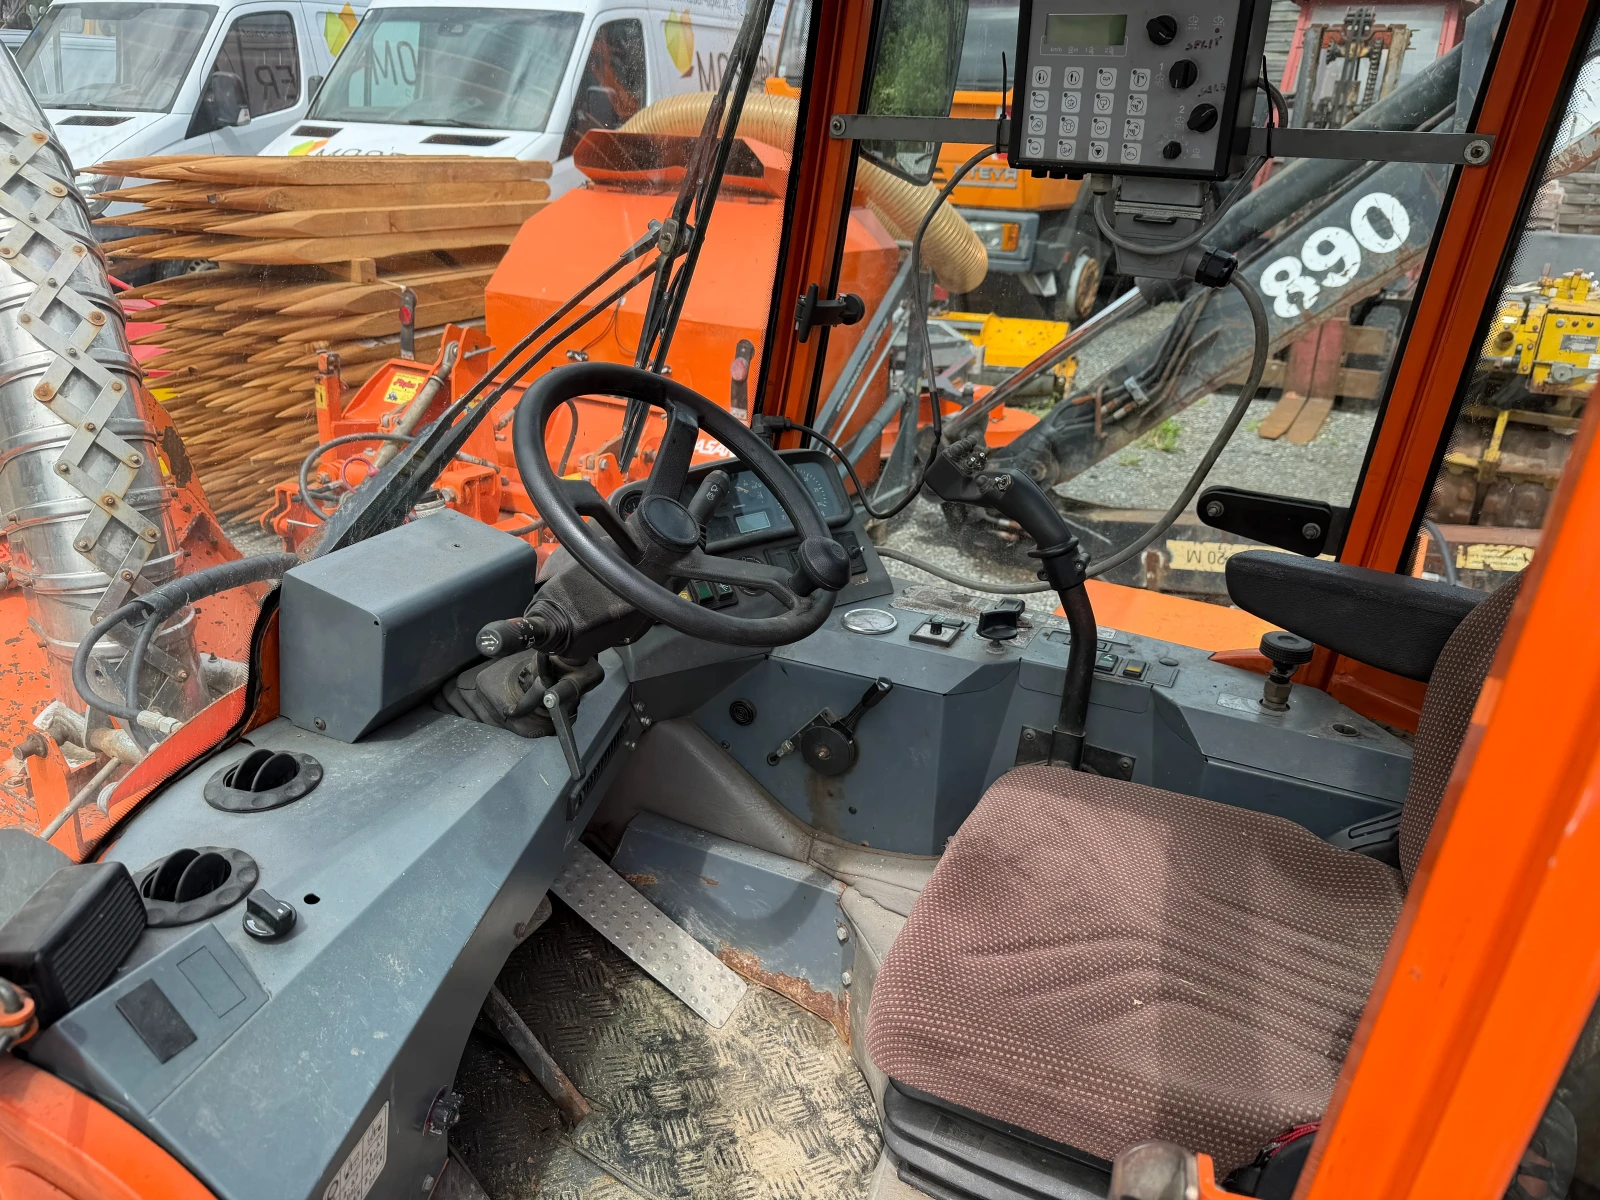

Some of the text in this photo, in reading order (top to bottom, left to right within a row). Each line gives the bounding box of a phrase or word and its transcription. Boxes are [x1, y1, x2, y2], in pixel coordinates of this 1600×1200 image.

[1185, 35, 1222, 51] SPLIT
[953, 166, 1018, 181] TEYR
[1260, 192, 1411, 318] 890
